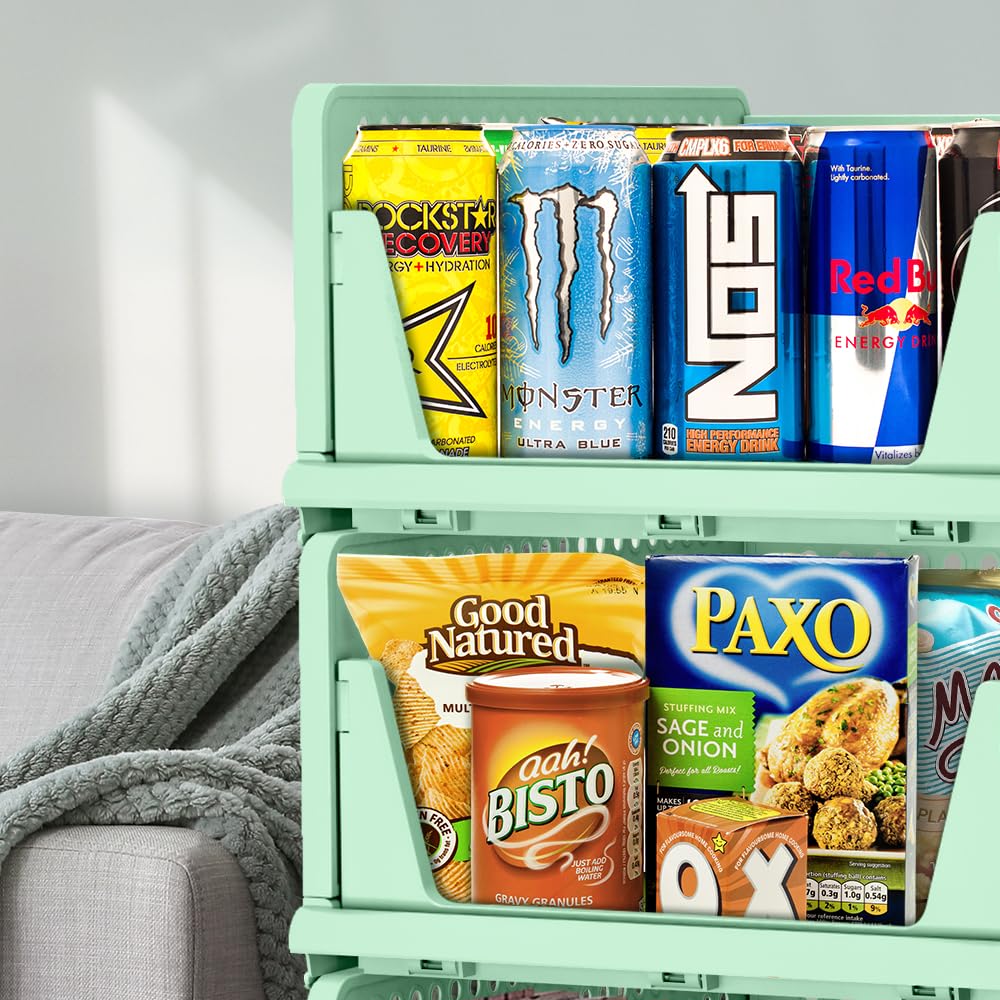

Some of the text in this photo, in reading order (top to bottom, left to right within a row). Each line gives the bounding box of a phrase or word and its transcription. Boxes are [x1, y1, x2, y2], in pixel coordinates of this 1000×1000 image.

[417, 144, 452, 153] TAURINE
[572, 140, 604, 150] ZERO
[383, 231, 492, 255] ECOVERY
[426, 259, 491, 272] HYDRATION
[830, 257, 900, 294] Red
[835, 335, 906, 349] ENERGY
[502, 381, 644, 413] MONSTER
[514, 418, 626, 432] ENERGY
[663, 427, 676, 440] 210
[686, 428, 779, 440] HIGH PERFORMANCE
[517, 437, 621, 449] ULTRA BLUE
[686, 438, 779, 453] ENERGY DRINK
[875, 449, 912, 460] Vitalizes
[453, 595, 549, 630] Good
[691, 587, 871, 672] PAXO
[429, 626, 577, 665] Natured
[663, 703, 736, 715] STUFFING MIX
[657, 718, 743, 739] SAGE and
[662, 738, 737, 759] ONION
[519, 735, 598, 782] aah!
[660, 766, 686, 777] Perfect
[686, 766, 700, 777] for
[701, 765, 711, 774] all
[487, 763, 615, 844] BISTO
[656, 797, 682, 805] MAKES
[430, 813, 451, 836] FREE
[742, 832, 774, 860] FLAVOURSOME
[775, 832, 789, 841] HOME
[572, 857, 606, 867] JUST ADD
[576, 865, 603, 874] BOILING
[578, 873, 602, 881] WATER
[495, 893, 593, 907] GRAVY GRANULES
[821, 889, 838, 899] 0.3g
[844, 891, 861, 900] 1.0g
[865, 892, 887, 902] 0.54g
[870, 904, 881, 912] 9%
